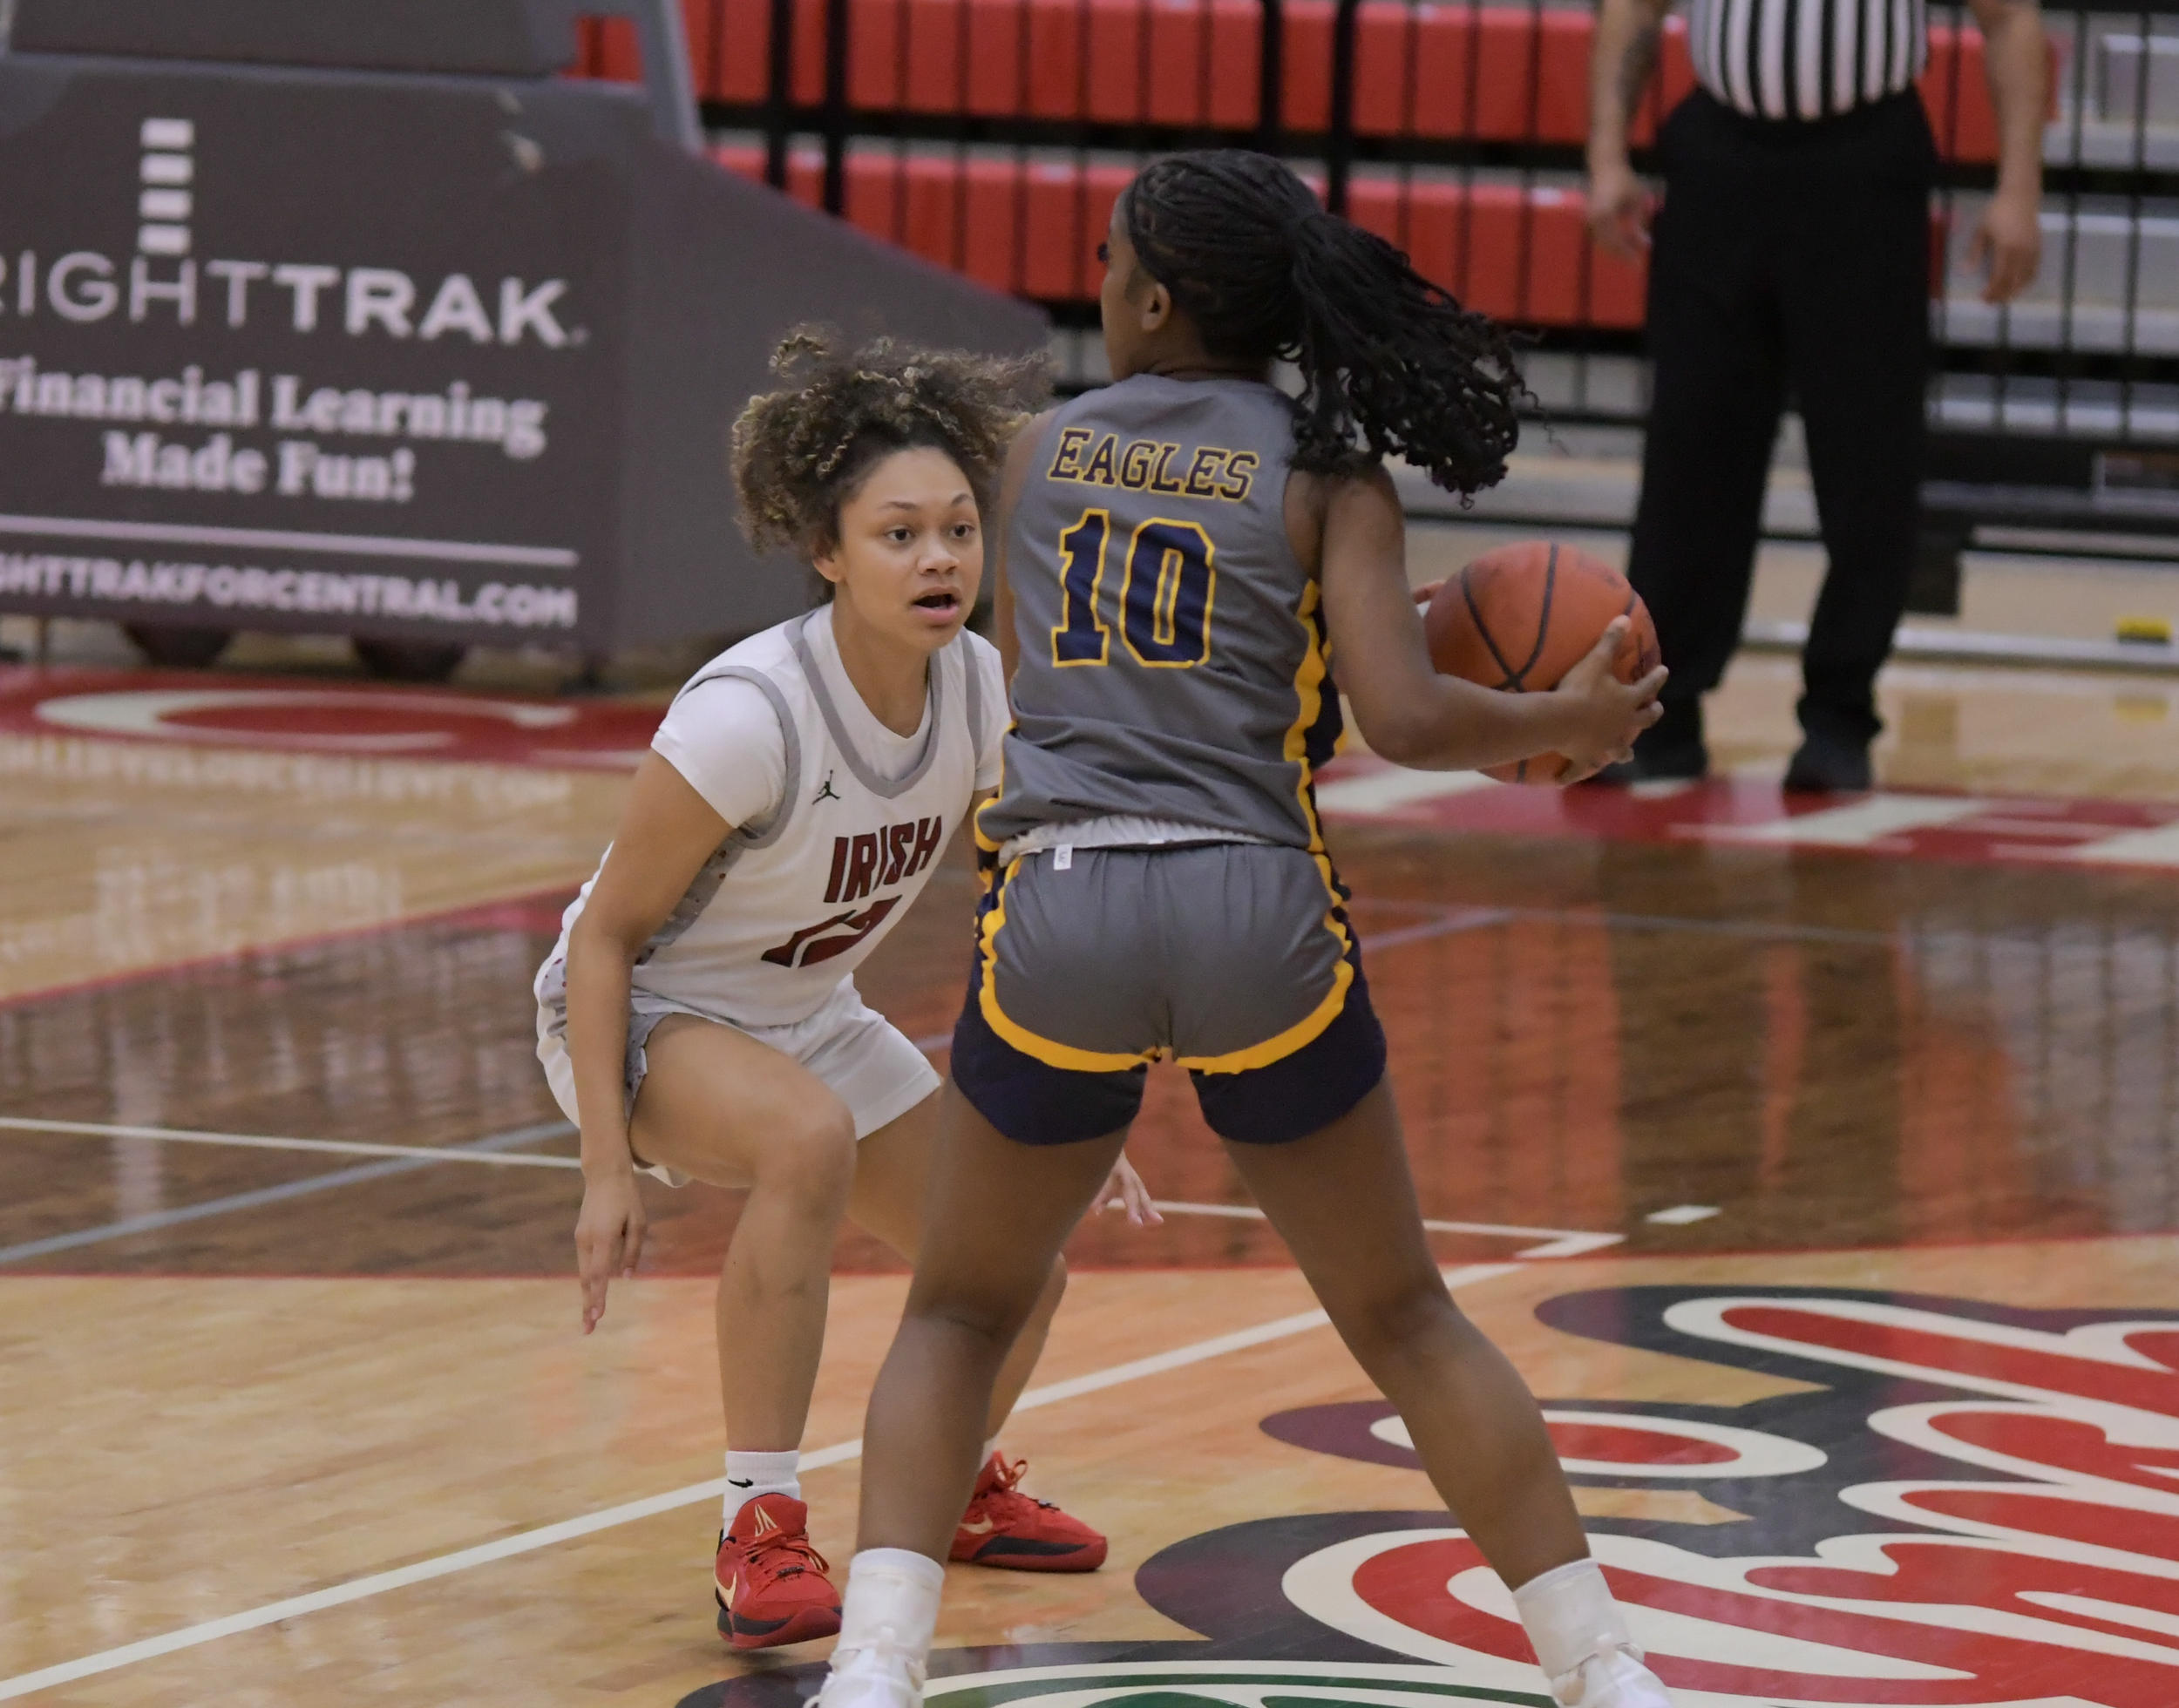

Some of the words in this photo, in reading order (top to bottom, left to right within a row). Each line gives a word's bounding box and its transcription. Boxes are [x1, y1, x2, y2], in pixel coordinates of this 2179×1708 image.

[0, 248, 569, 348] IGHTTRAK
[272, 375, 546, 459] Learning
[102, 431, 267, 494] Made
[276, 439, 416, 503] Fun!
[1048, 427, 1260, 502] EAGLES
[1051, 508, 1216, 668] 10
[823, 815, 942, 903] IRISH
